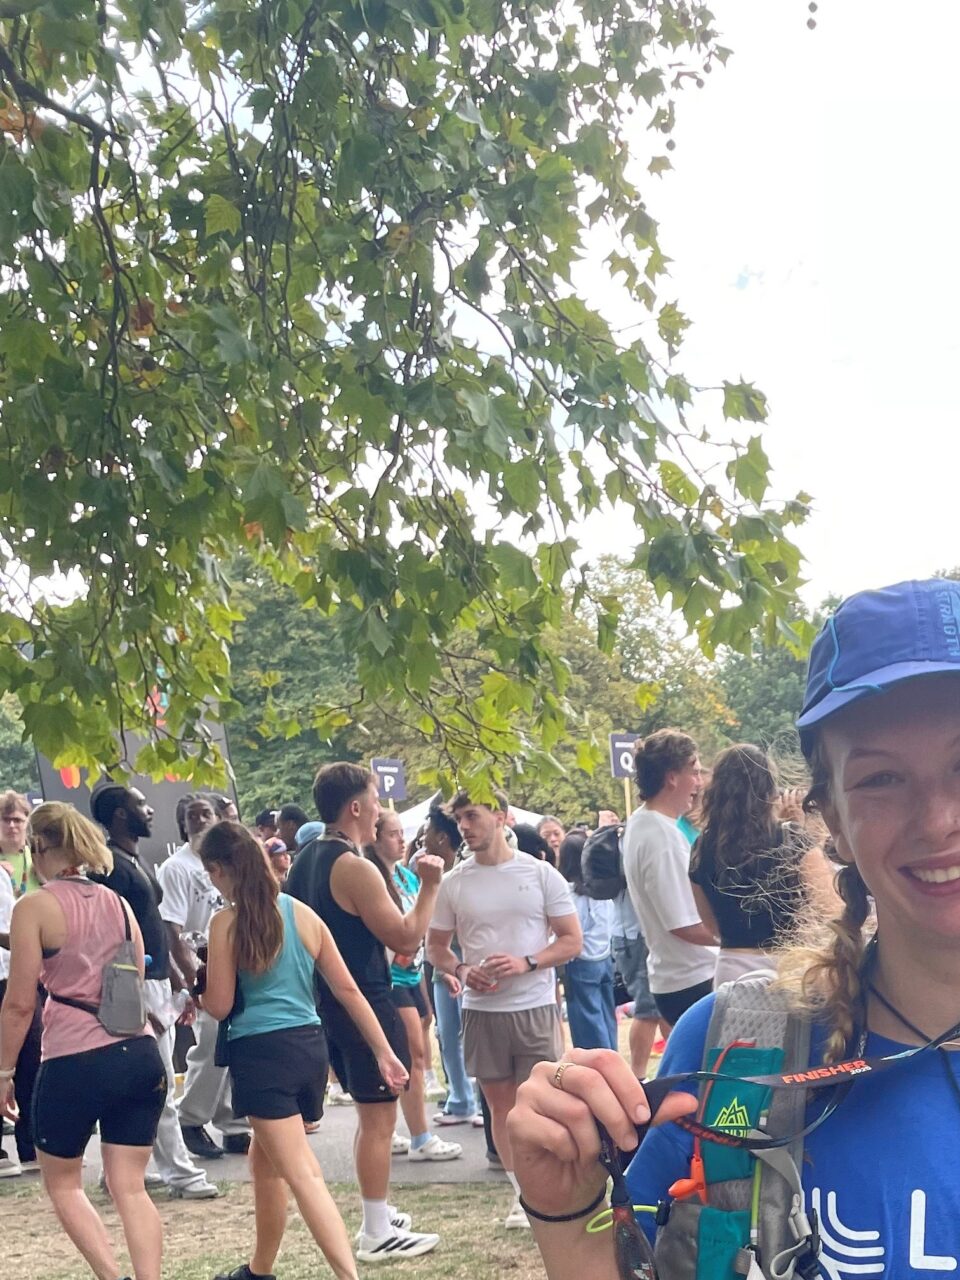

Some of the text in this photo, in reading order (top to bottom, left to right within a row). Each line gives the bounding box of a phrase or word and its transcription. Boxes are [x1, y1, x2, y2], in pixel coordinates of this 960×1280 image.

[620, 751, 634, 772] Q
[384, 775, 395, 792] P
[782, 1060, 867, 1083] FINISHER
